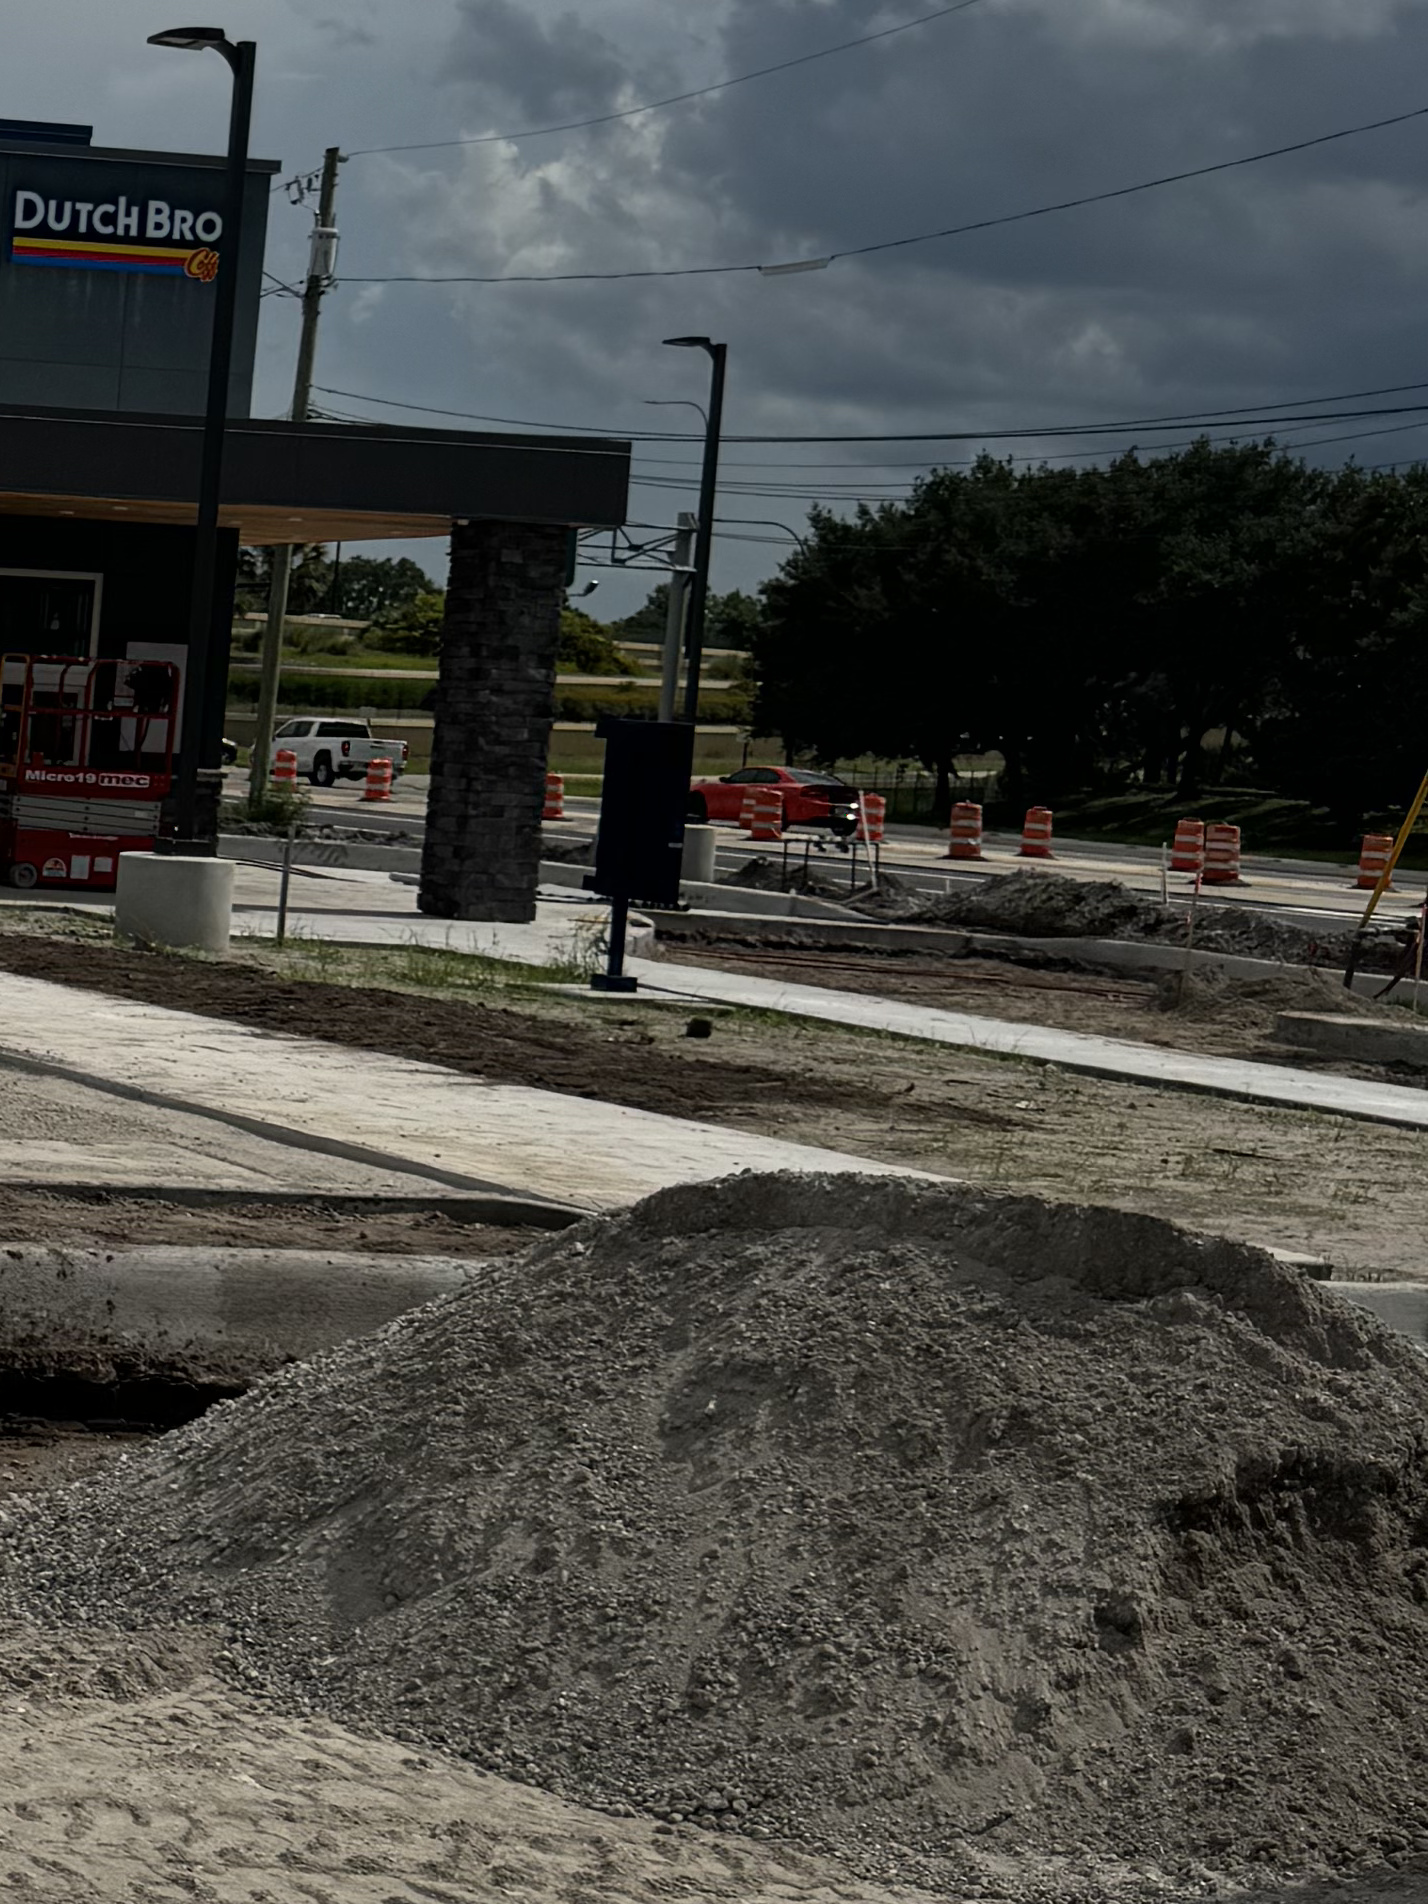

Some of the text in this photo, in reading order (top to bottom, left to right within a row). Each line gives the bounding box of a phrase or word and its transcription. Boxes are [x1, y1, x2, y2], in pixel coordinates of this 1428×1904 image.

[145, 199, 223, 243] BRO
[186, 248, 220, 282] Coff
[24, 769, 149, 788] Micro19 mec
